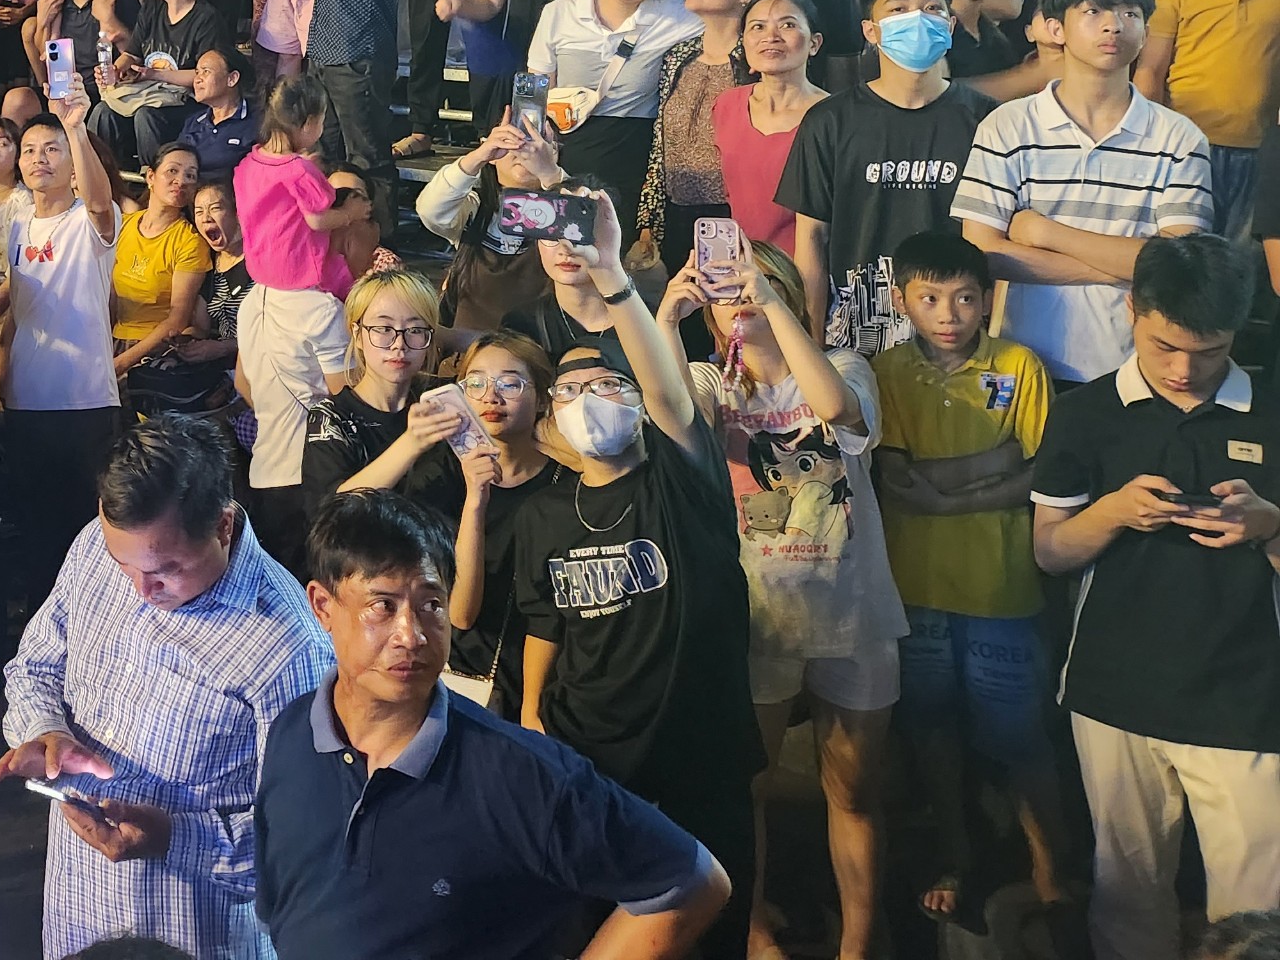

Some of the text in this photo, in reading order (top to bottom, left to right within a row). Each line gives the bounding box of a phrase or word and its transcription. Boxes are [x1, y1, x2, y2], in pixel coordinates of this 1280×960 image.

[865, 160, 958, 184] GROUND
[569, 544, 625, 558] EVERY TIME
